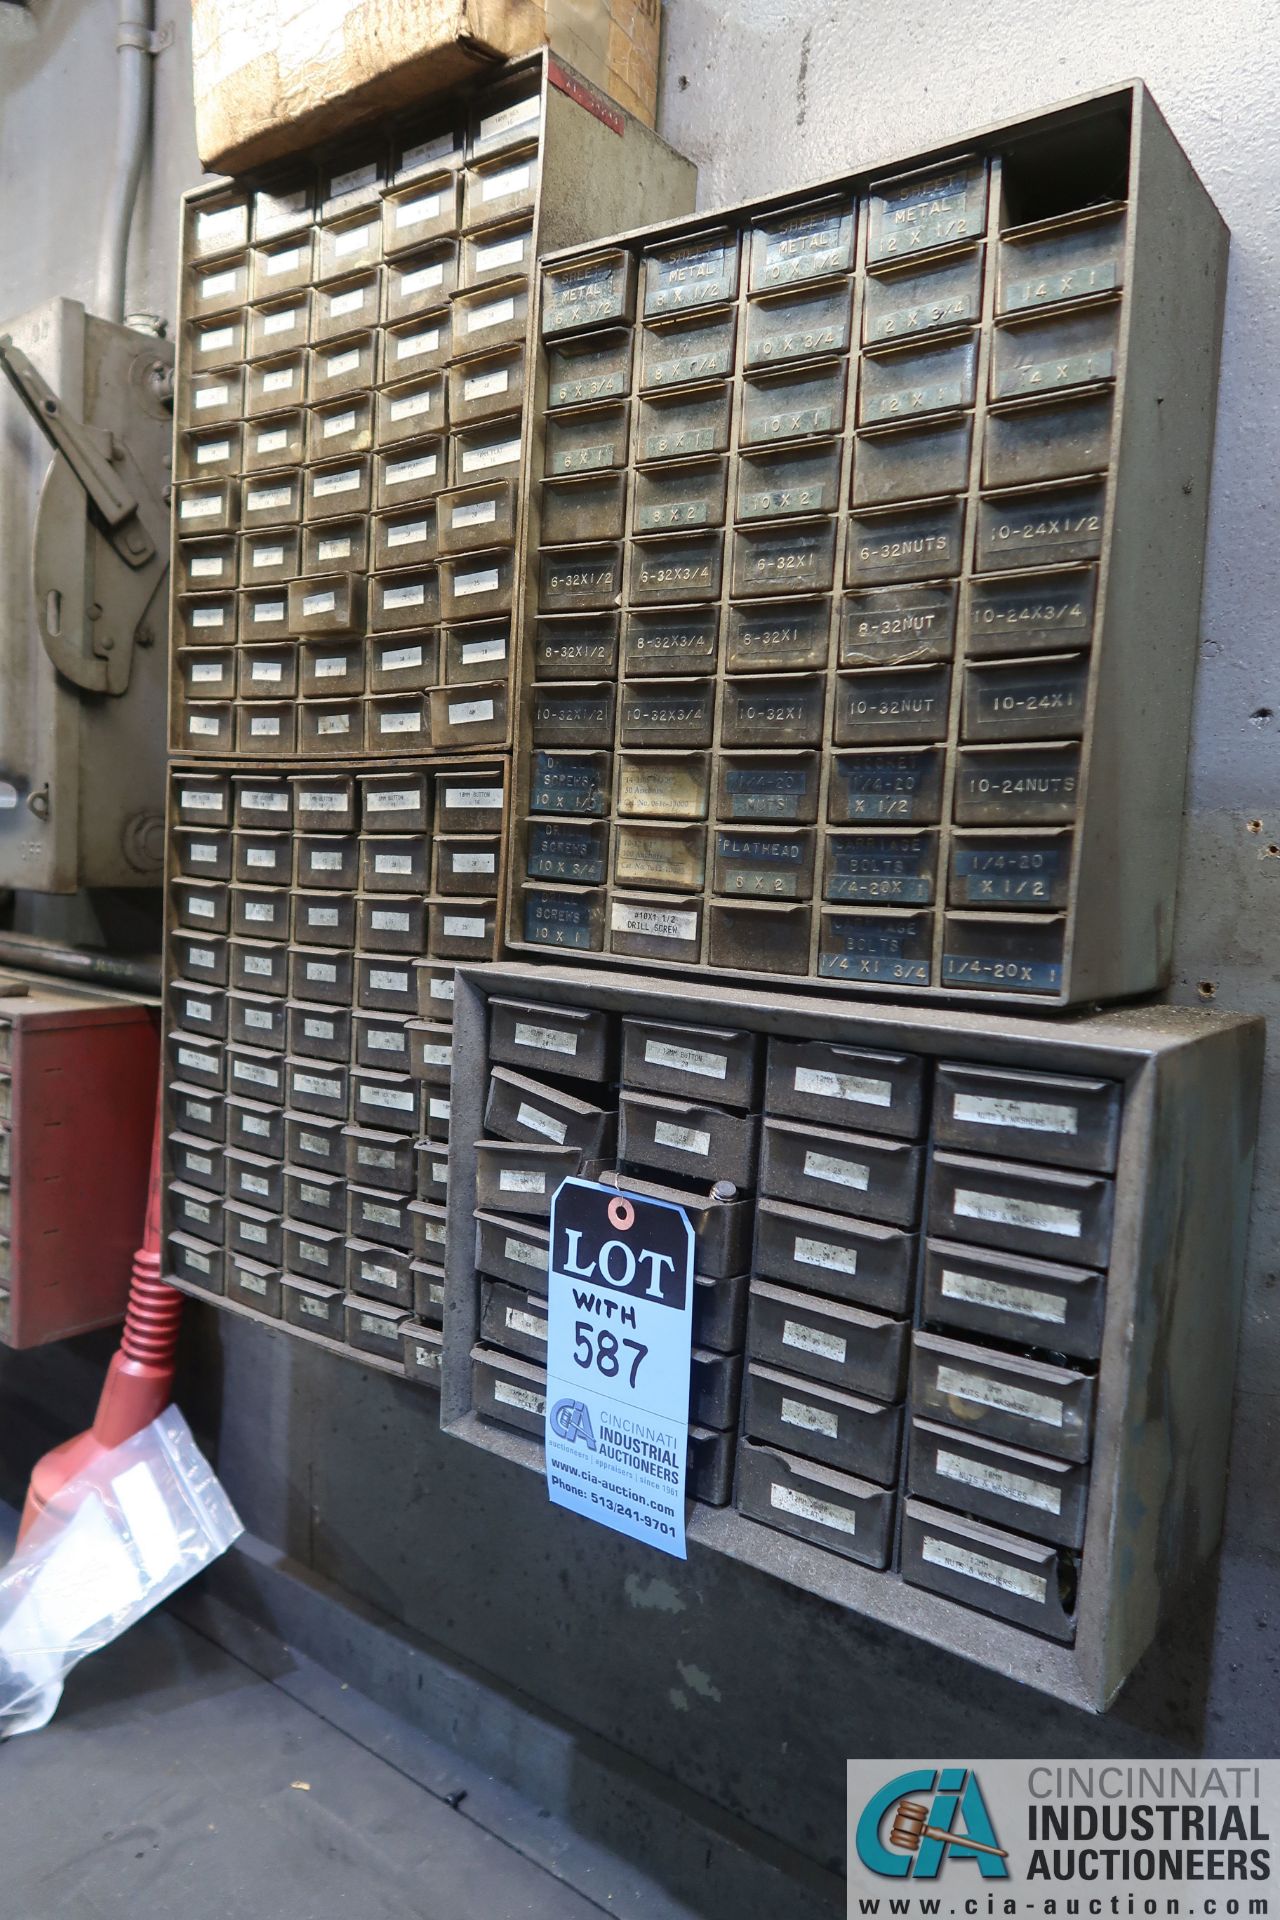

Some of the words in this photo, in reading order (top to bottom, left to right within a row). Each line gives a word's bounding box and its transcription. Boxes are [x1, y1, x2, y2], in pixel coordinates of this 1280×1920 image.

[895, 198, 951, 224] METAL
[779, 233, 829, 255] METAL
[880, 238, 896, 253] 12
[911, 230, 921, 247] X
[937, 219, 967, 238] 1/2
[669, 262, 714, 283] METAL
[763, 265, 781, 282] 10
[790, 262, 801, 276] X
[813, 254, 841, 269] 1/2
[561, 285, 602, 303] METAL
[674, 288, 682, 305] X
[694, 284, 720, 299] 1/2
[1024, 284, 1048, 300] 14
[1061, 277, 1073, 293] X
[1089, 270, 1096, 286] 1
[555, 313, 563, 325] 6
[571, 308, 580, 321] X
[588, 301, 612, 318] 1/2
[877, 319, 896, 333] 12
[908, 311, 919, 327] X
[932, 299, 964, 320] 3/4
[755, 342, 773, 355] 10
[783, 339, 793, 352] X
[804, 334, 834, 349] 3/4
[654, 368, 663, 381] 8
[672, 363, 680, 376] X
[1056, 364, 1068, 379] X
[559, 387, 567, 401] 6
[575, 384, 583, 397] X
[590, 377, 614, 393] 3/4
[880, 398, 899, 412] 12
[912, 393, 923, 407] X
[763, 420, 782, 434] 10
[791, 417, 801, 430] X
[814, 412, 820, 425] 1
[675, 435, 685, 448] X
[564, 456, 572, 468] 6
[579, 452, 588, 465] X
[752, 495, 771, 511] 10
[780, 494, 791, 507] X
[800, 492, 810, 505] 2
[671, 508, 679, 521] X
[687, 506, 696, 519] 2
[991, 515, 1102, 541] 10-24X1/2
[860, 536, 948, 560] 6-32NUTS
[757, 553, 815, 571] 6-32X1
[551, 571, 613, 588] 6-32X1/2
[641, 566, 710, 583] 6-32X3/4
[972, 603, 1083, 625] 10-24X3/4
[858, 614, 936, 637] 8-32NUT
[636, 634, 706, 650] 8-32X3/4
[742, 628, 798, 646] 8-32X1
[545, 645, 606, 659] 8-32X1/2
[850, 698, 935, 716] 10-32NUT
[993, 692, 1074, 711] 10-24X1
[536, 705, 603, 722] 10-32X1/2
[627, 706, 703, 722] 10-32X3/4
[740, 706, 804, 722] 10-32X1
[968, 777, 1076, 794] 10-24NUTS
[536, 793, 550, 806] 10
[556, 796, 564, 808] X
[855, 800, 865, 813] X
[878, 799, 909, 814] 1/2
[539, 859, 553, 871] 10
[557, 861, 566, 874] X
[572, 863, 597, 876] 3/4
[971, 853, 1044, 872] 1/4-20
[754, 875, 764, 890] X
[774, 878, 785, 892] 2
[830, 880, 903, 896] /4-20X
[981, 879, 994, 894] X
[1004, 879, 1045, 897] 1/2
[626, 920, 650, 932] DRILL
[653, 922, 679, 934] SCREW
[661, 913, 677, 924] 1/2
[535, 927, 549, 939] 10
[556, 930, 564, 943] X
[575, 931, 580, 944] 1
[822, 953, 849, 970] 1/4
[893, 963, 928, 979] 3/4
[563, 1227, 675, 1299] LOT
[572, 1287, 637, 1330] WITH
[573, 1320, 648, 1389] 587
[600, 1410, 679, 1450] CINCINNATI
[599, 1425, 680, 1469] INDUSTRIAL
[548, 1439, 589, 1461] auctioneers
[595, 1459, 633, 1480] appraisers
[640, 1476, 660, 1490] since
[662, 1484, 679, 1498] 1961
[599, 1443, 680, 1485] AUCTIONEERS
[958, 1471, 979, 1485] NUTS
[551, 1458, 676, 1518] www.cia-auction.com
[552, 1474, 588, 1500] Phone:
[591, 1491, 676, 1539] 513/241-9701
[944, 1558, 965, 1572] NUTS
[977, 1568, 1013, 1589] WASHERS
